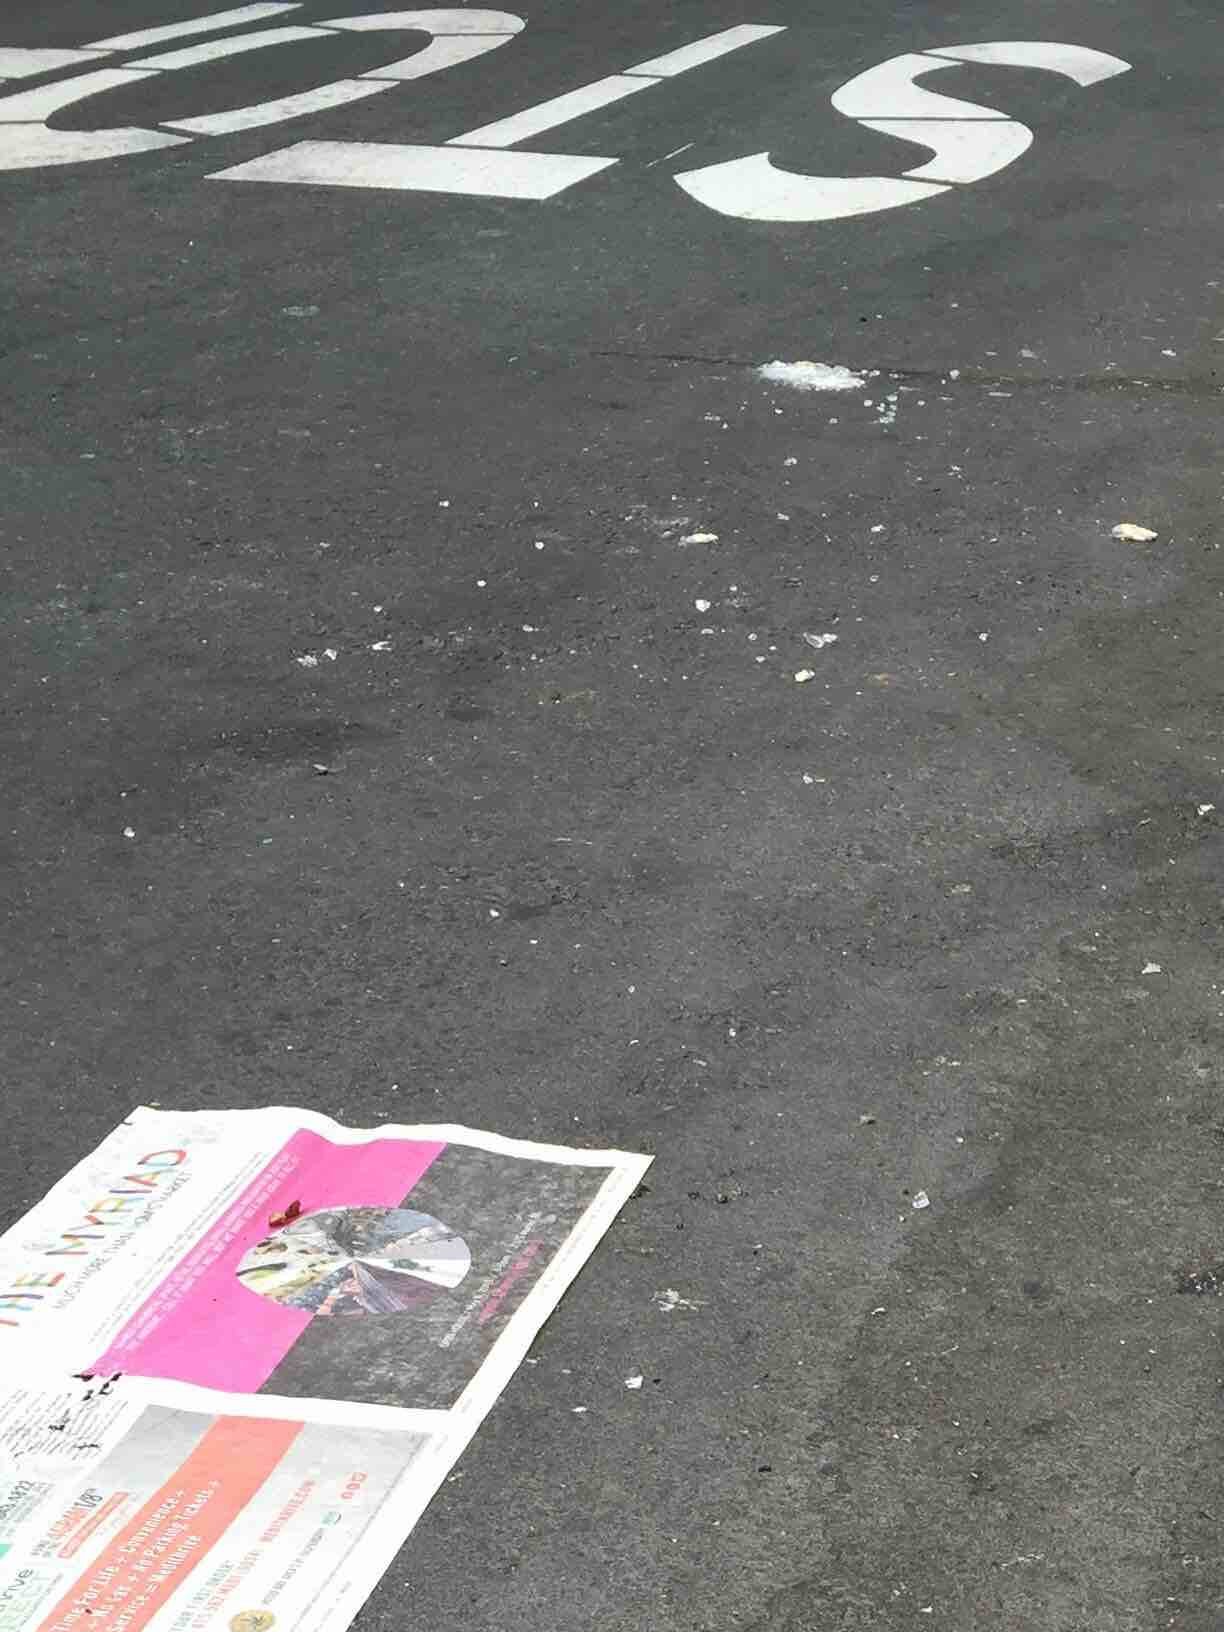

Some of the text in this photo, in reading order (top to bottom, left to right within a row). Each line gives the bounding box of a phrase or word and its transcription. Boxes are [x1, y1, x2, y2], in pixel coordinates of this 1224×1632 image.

[45, 1149, 187, 1256] MYRIAD
[53, 1604, 83, 1632] Time
[78, 1584, 101, 1608] For
